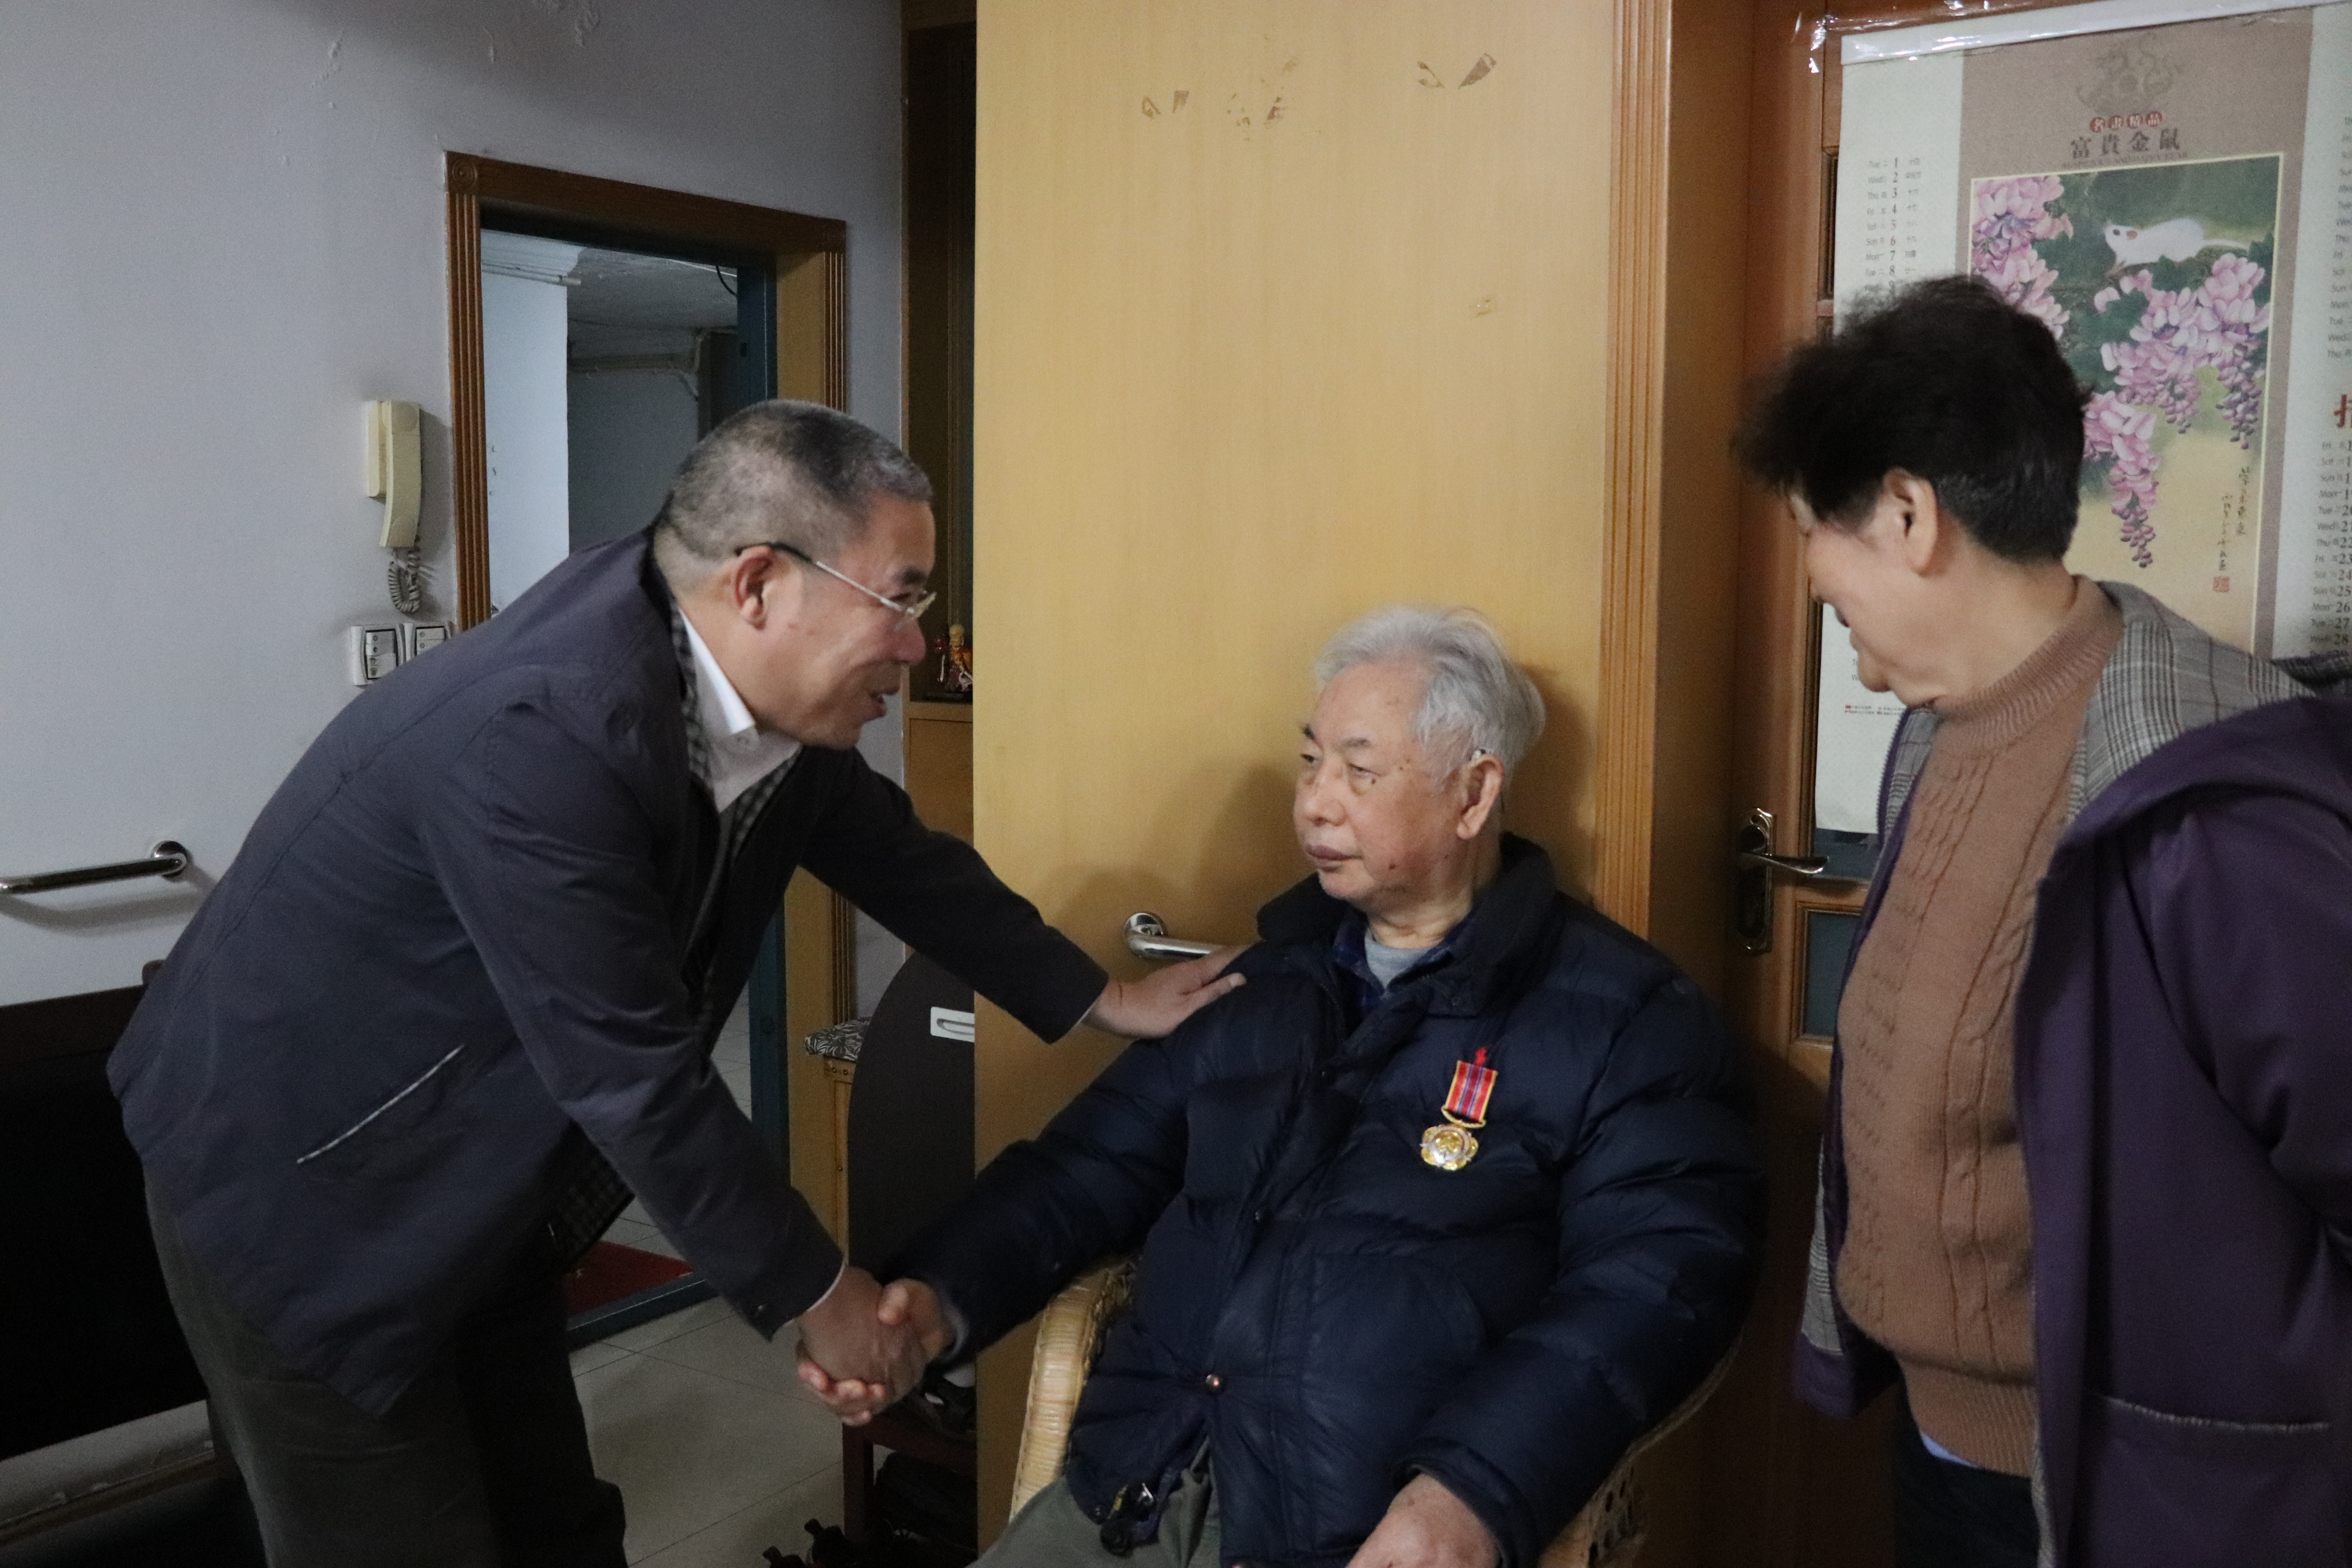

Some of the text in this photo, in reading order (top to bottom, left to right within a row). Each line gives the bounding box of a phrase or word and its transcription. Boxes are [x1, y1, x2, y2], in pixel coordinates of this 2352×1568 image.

[2071, 128, 2180, 159] 富貴金鼠
[1894, 157, 1898, 167] 1
[1893, 172, 1898, 183] 2
[1892, 187, 1897, 198] 3
[1892, 203, 1896, 214] 4
[1891, 220, 1896, 230] 5
[1891, 236, 1896, 246] 6
[1890, 250, 1895, 261] 7
[1889, 265, 1895, 276] 8
[2345, 488, 2352, 500] 1
[2337, 586, 2351, 597] 25
[2336, 601, 2350, 612] 26
[2335, 617, 2350, 629] 27
[2334, 633, 2348, 645] 28
